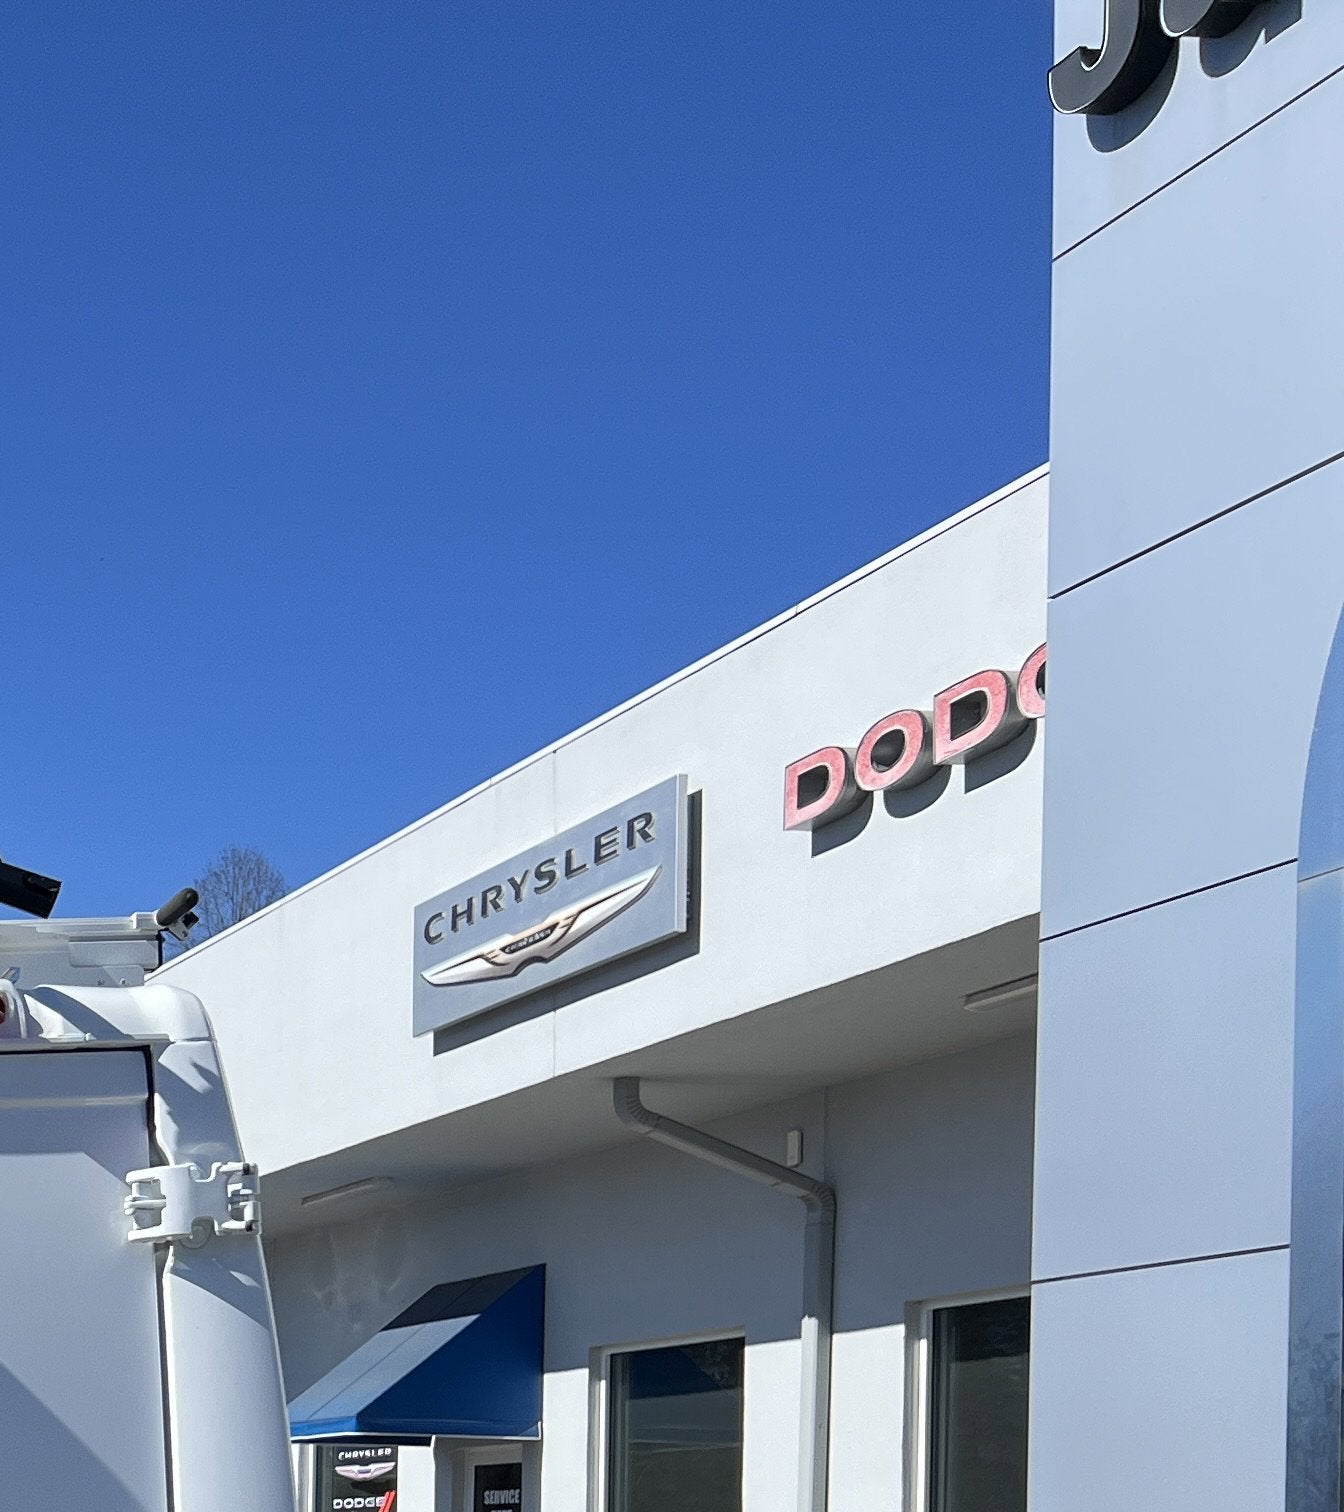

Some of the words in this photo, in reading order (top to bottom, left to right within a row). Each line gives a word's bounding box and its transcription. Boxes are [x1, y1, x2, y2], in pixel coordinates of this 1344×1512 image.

[424, 812, 656, 945] CHRYSLER
[333, 1496, 385, 1510] DODGE
[484, 1489, 520, 1505] SERVICE
